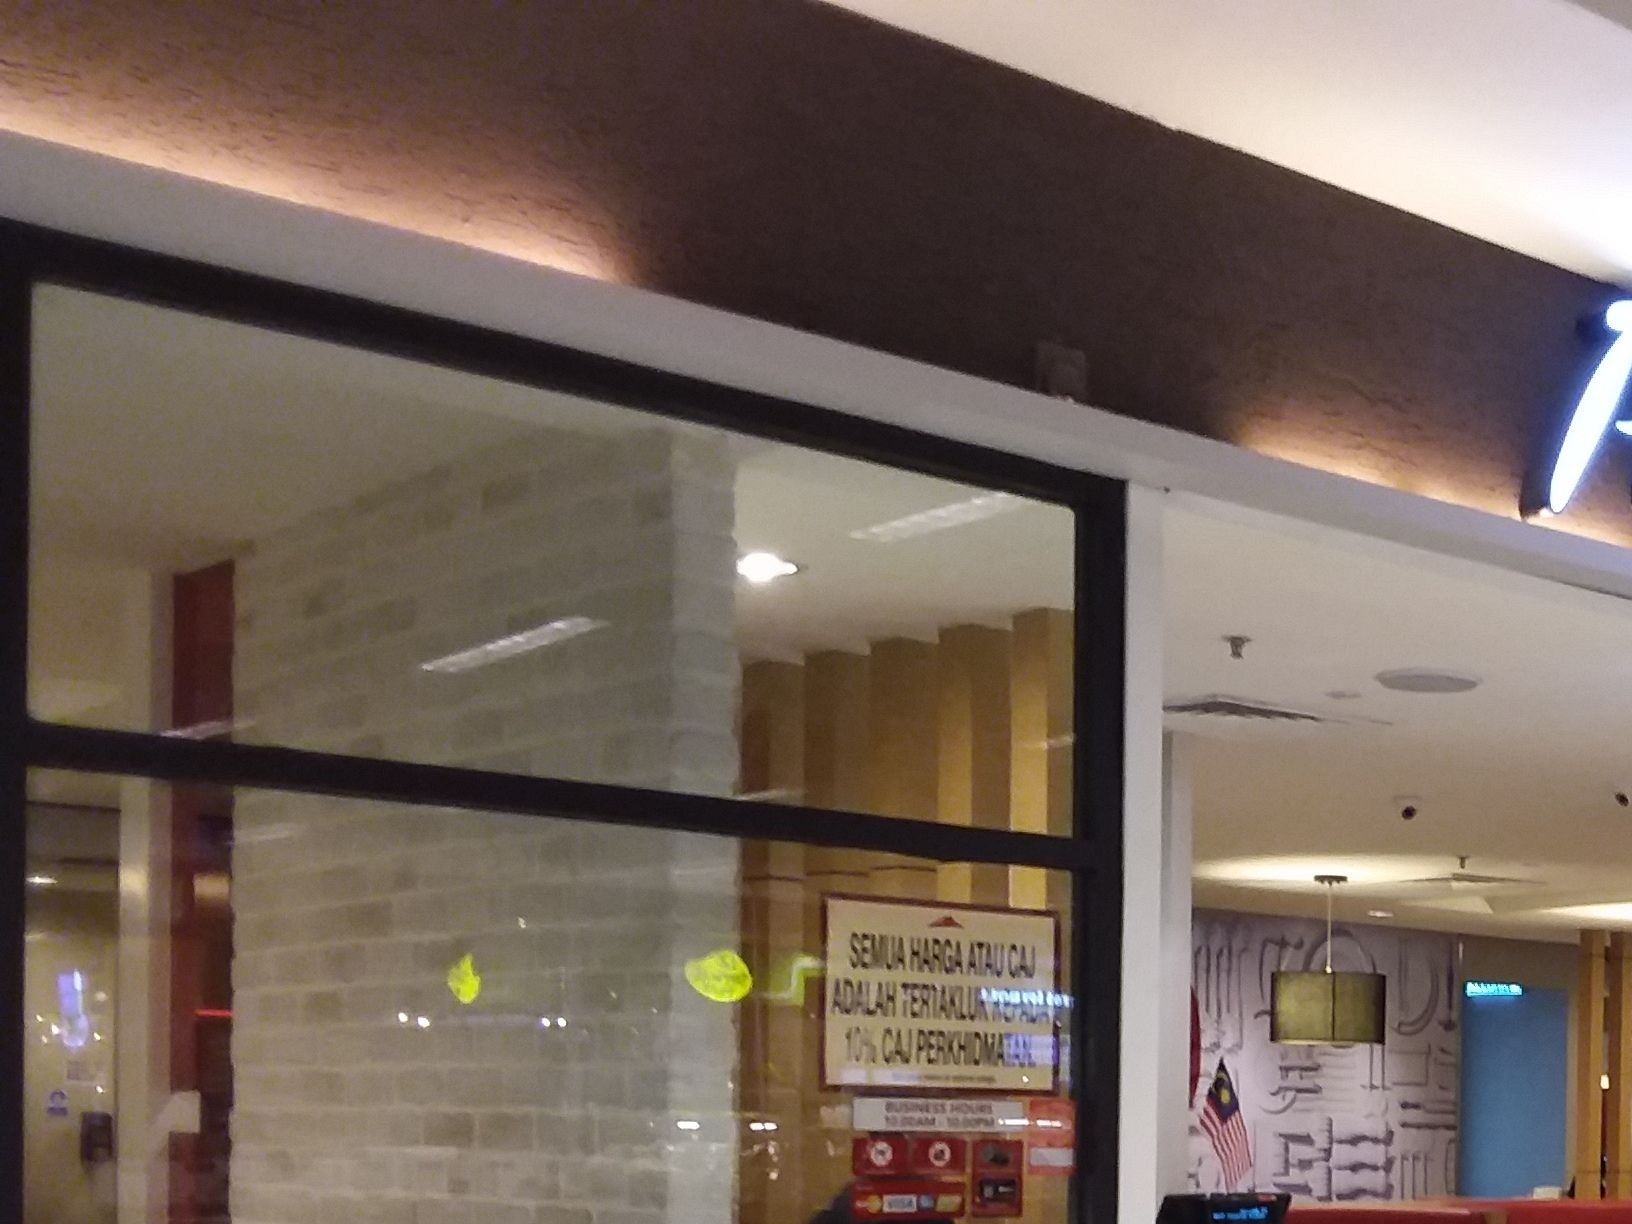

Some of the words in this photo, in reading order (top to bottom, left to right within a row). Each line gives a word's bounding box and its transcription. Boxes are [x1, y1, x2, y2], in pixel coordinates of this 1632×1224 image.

[850, 931, 905, 970] SEMUA
[909, 936, 963, 975] HARGA
[967, 941, 1005, 977] ATAU
[1008, 943, 1036, 979] CAJ
[832, 978, 897, 1018] ADALAH
[882, 1027, 912, 1065] CAJ
